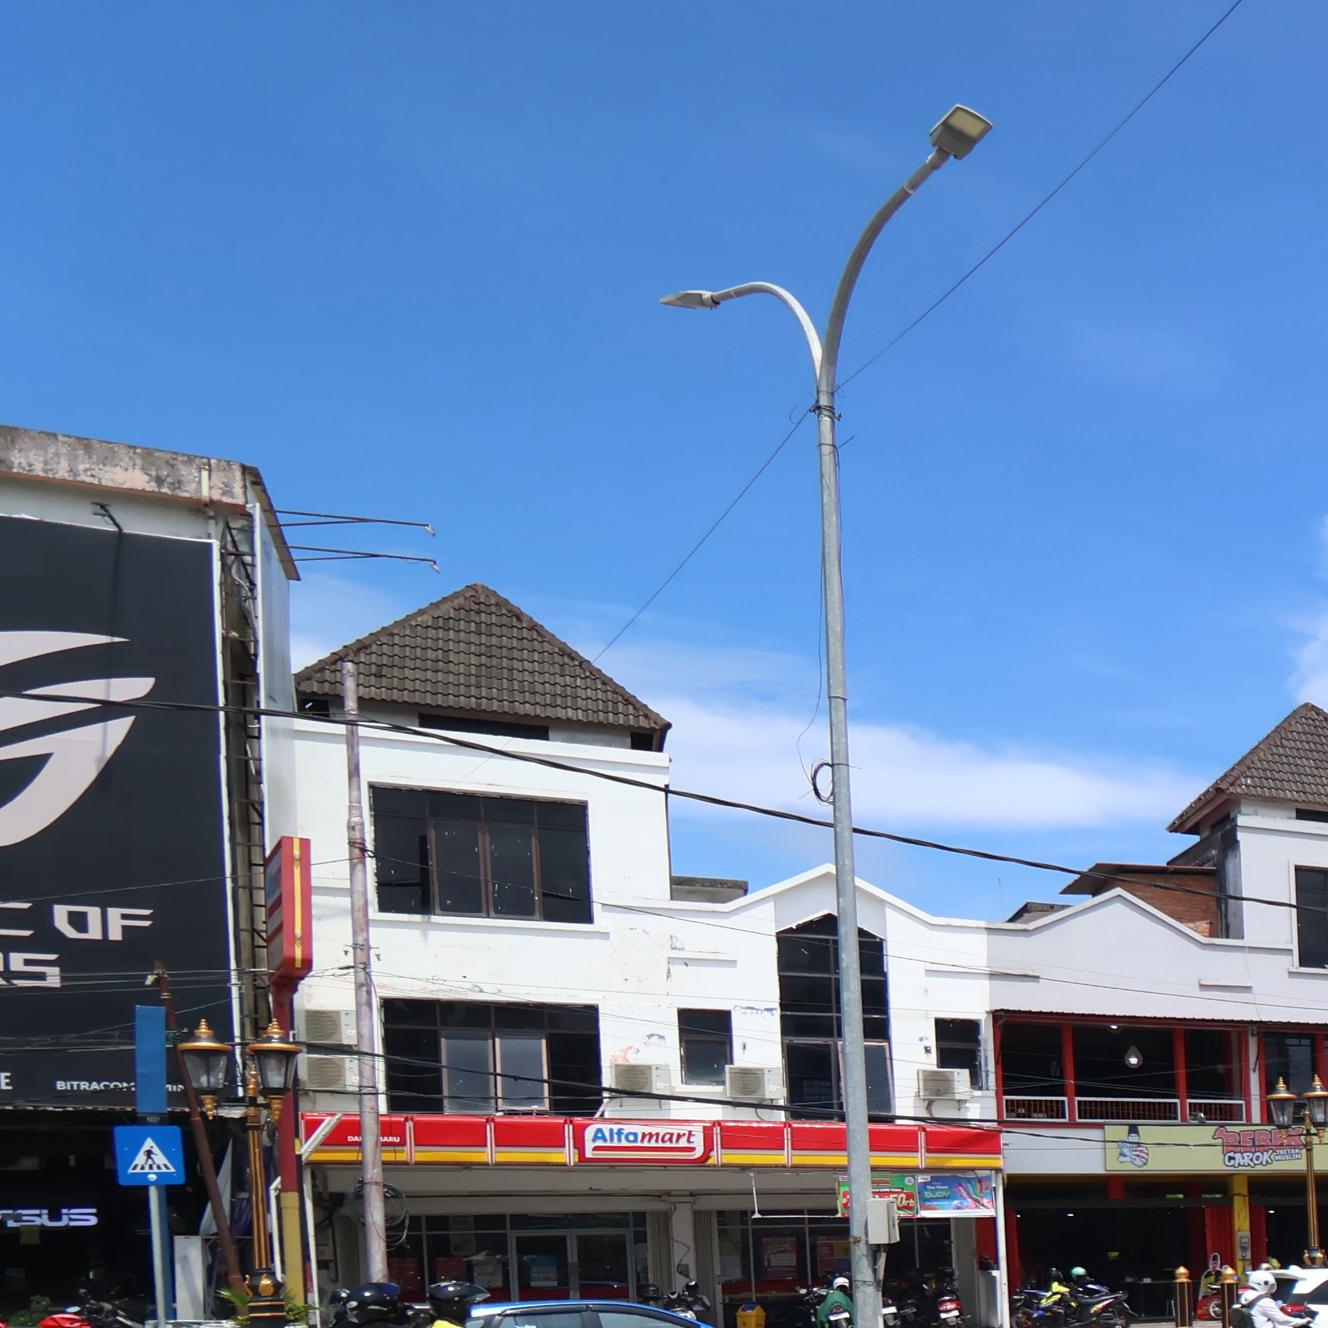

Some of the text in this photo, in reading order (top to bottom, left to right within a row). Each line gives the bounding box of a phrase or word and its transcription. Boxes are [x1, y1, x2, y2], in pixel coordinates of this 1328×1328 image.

[53, 904, 154, 941] OF
[592, 1127, 696, 1145] Alfamart
[1222, 1127, 1305, 1153] BEBEK
[1224, 1149, 1273, 1167] CAROK
